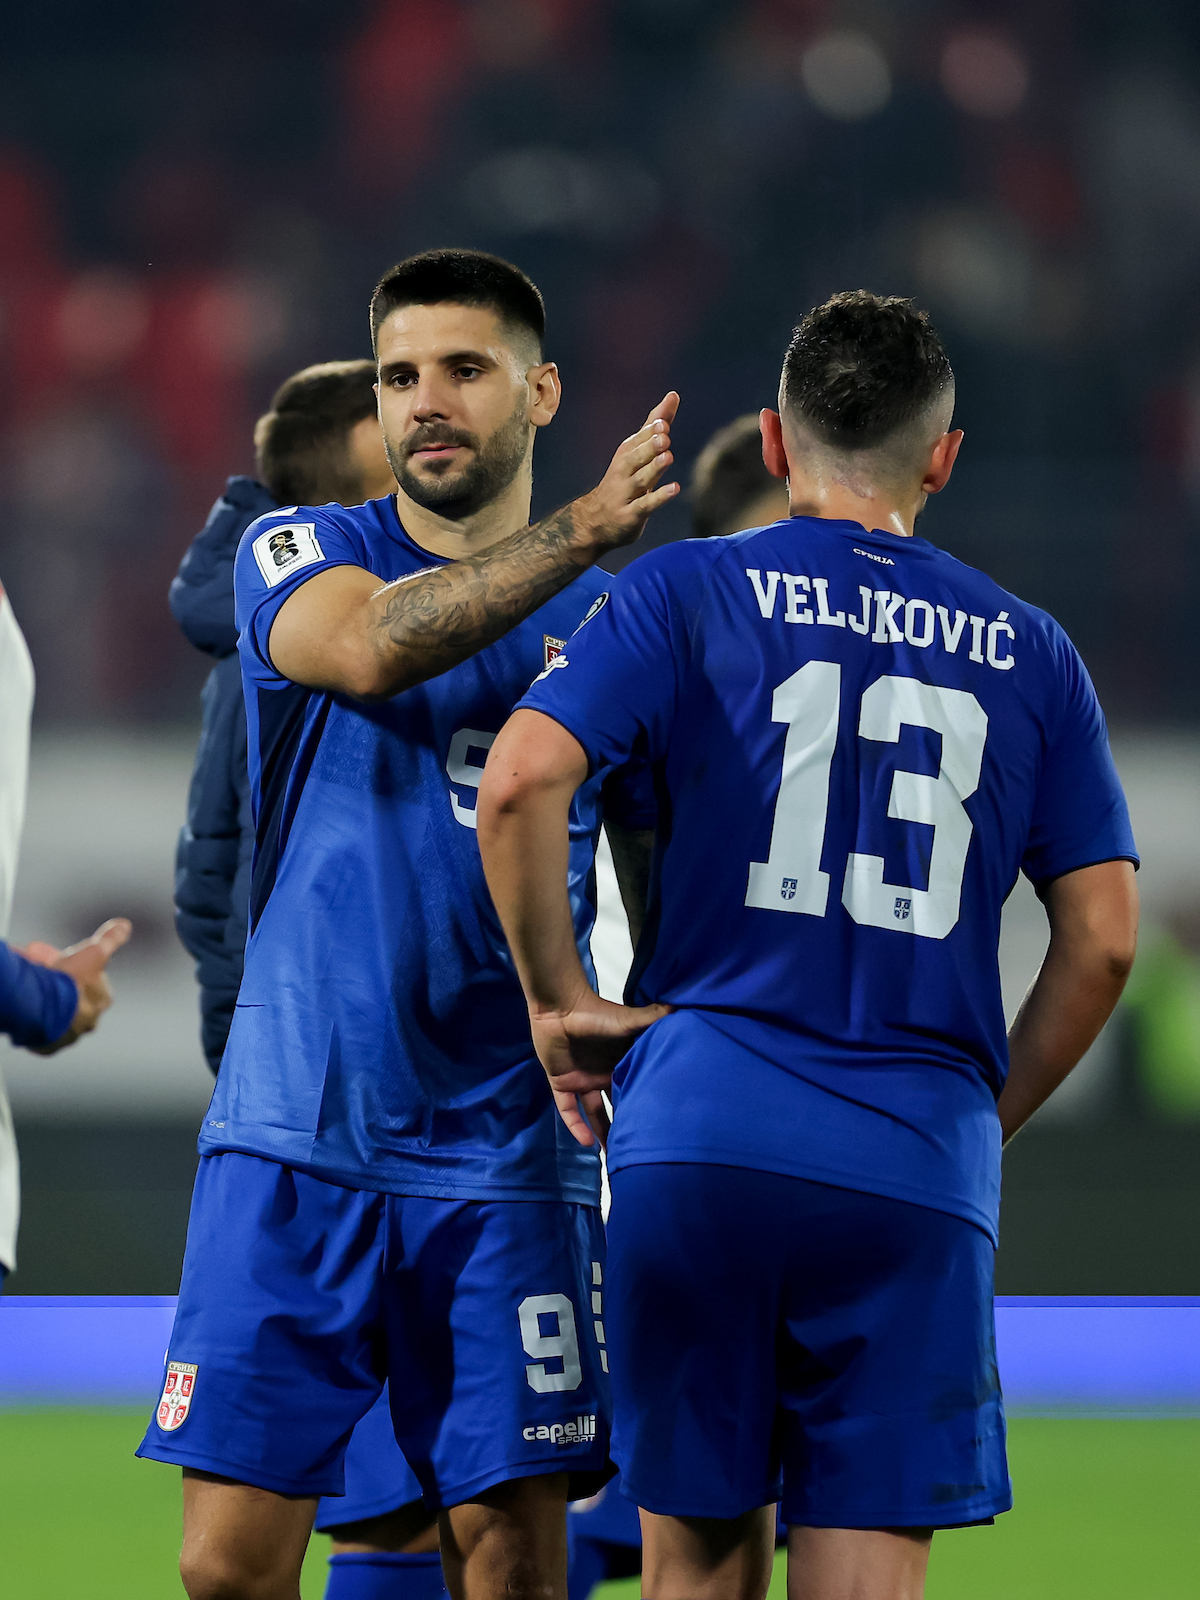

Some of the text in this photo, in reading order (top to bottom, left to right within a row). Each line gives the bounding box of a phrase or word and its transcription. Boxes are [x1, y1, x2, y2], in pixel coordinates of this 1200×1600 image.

[545, 636, 568, 648] СРБ
[745, 568, 1016, 671] VELJKOVIĆ
[744, 659, 989, 940] 13
[517, 1293, 583, 1394] 9
[522, 1414, 597, 1444] capelli
[557, 1434, 596, 1445] SPORT
